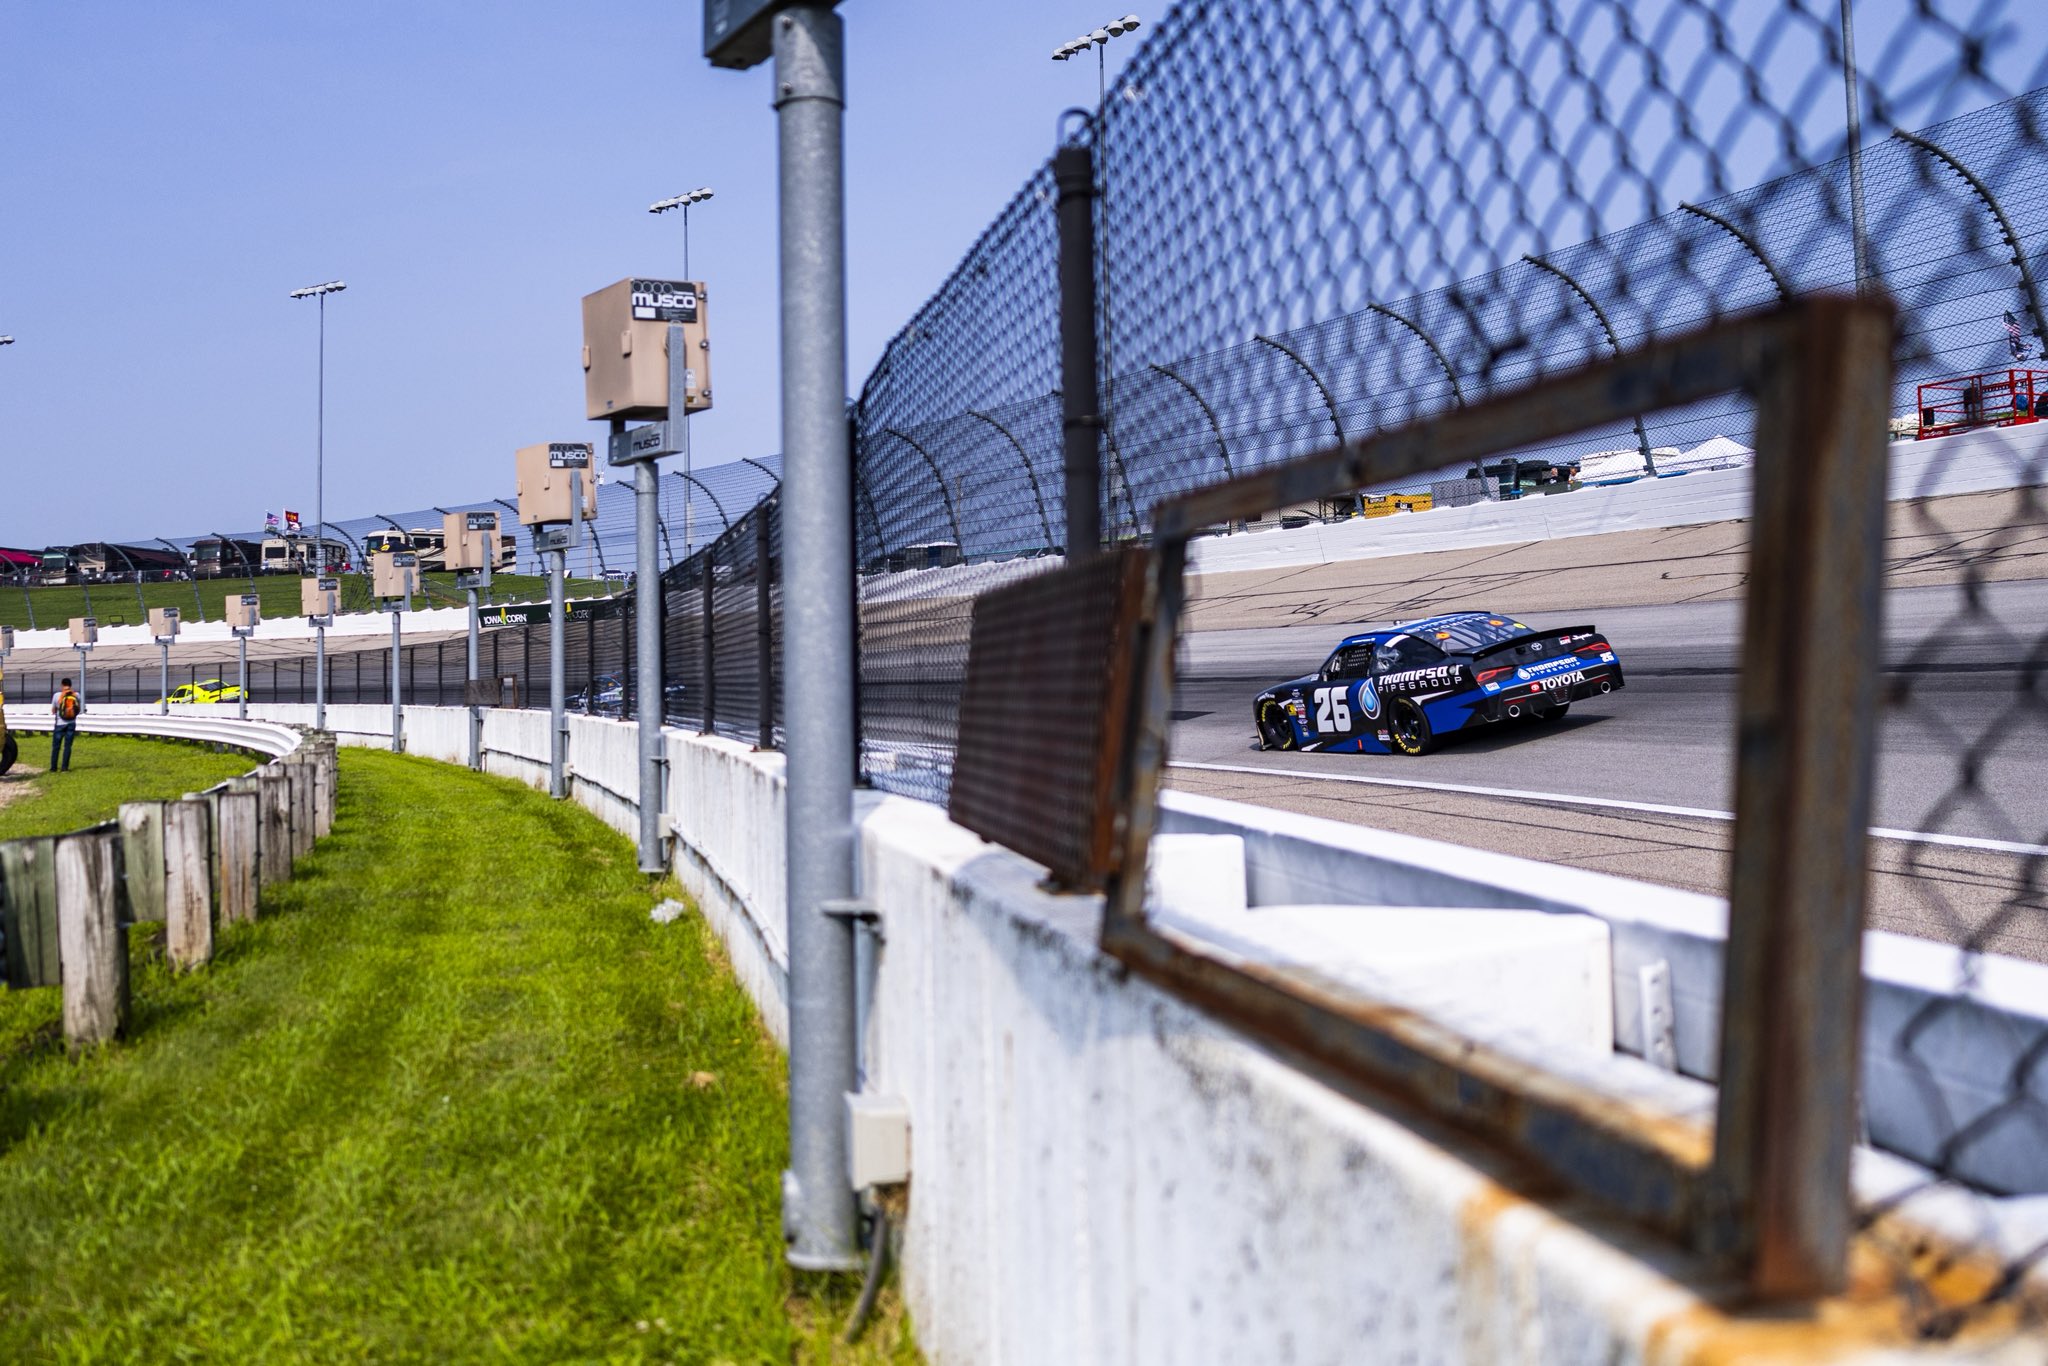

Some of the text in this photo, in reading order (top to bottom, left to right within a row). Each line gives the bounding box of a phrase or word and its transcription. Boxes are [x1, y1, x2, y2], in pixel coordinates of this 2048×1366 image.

[484, 613, 527, 625] IOWA CORN
[1526, 656, 1578, 673] THOMPSON
[1377, 676, 1463, 694] PIPEGROUP
[1540, 670, 1585, 691] TOYOTA
[1313, 686, 1352, 733] 26
